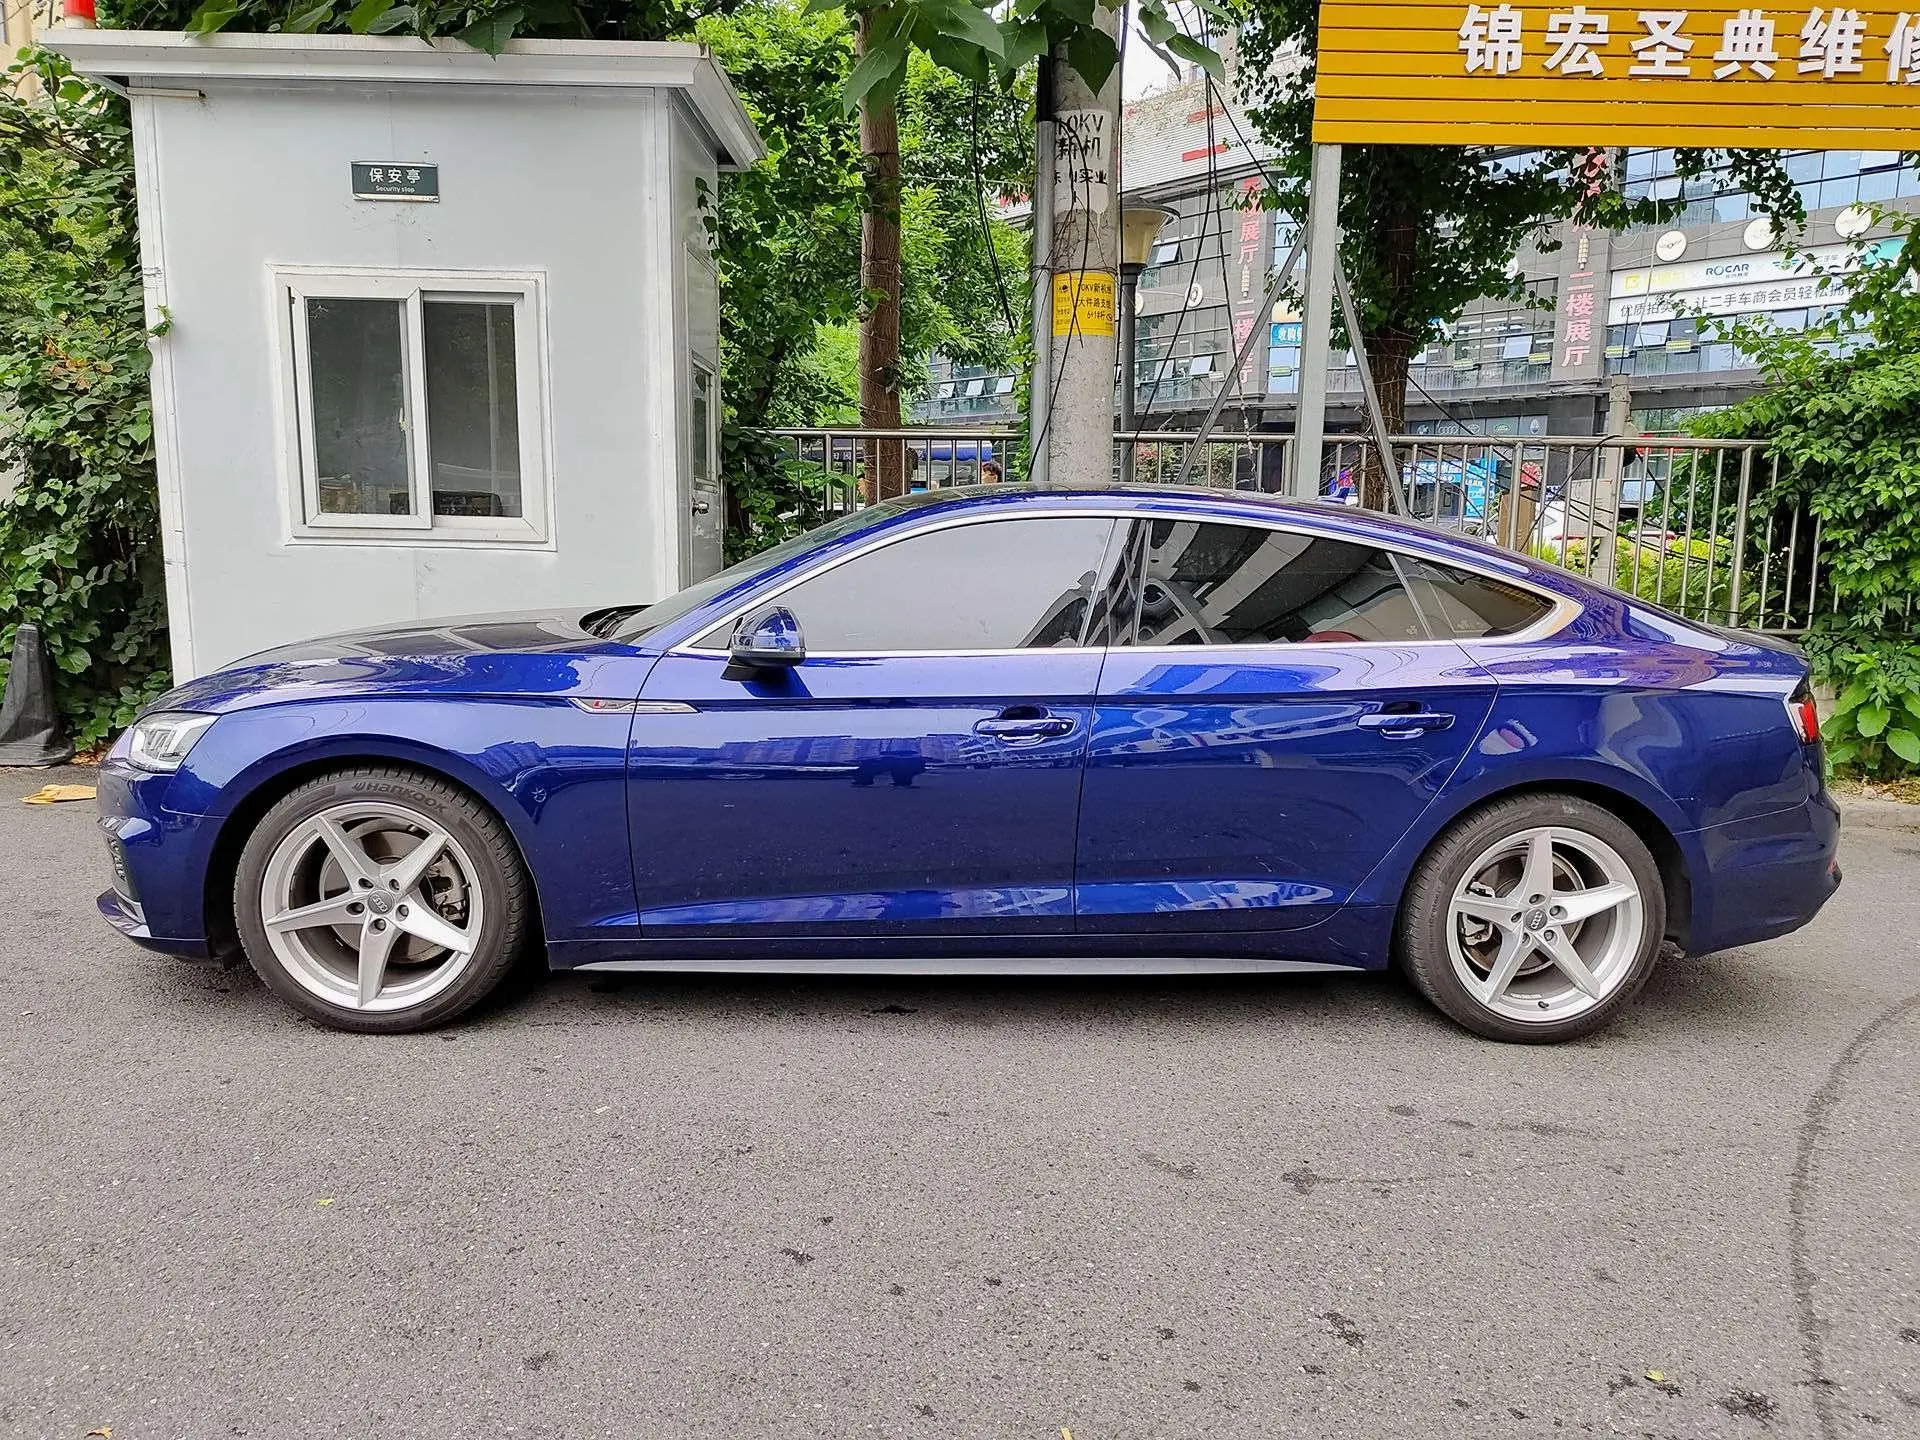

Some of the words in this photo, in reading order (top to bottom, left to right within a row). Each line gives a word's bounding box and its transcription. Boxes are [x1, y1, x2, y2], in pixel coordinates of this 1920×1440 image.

[369, 168, 421, 184] 保安亭
[375, 185, 401, 193] Security
[1706, 263, 1750, 276] ROCAR
[1561, 271, 1595, 368] 二楼展厅
